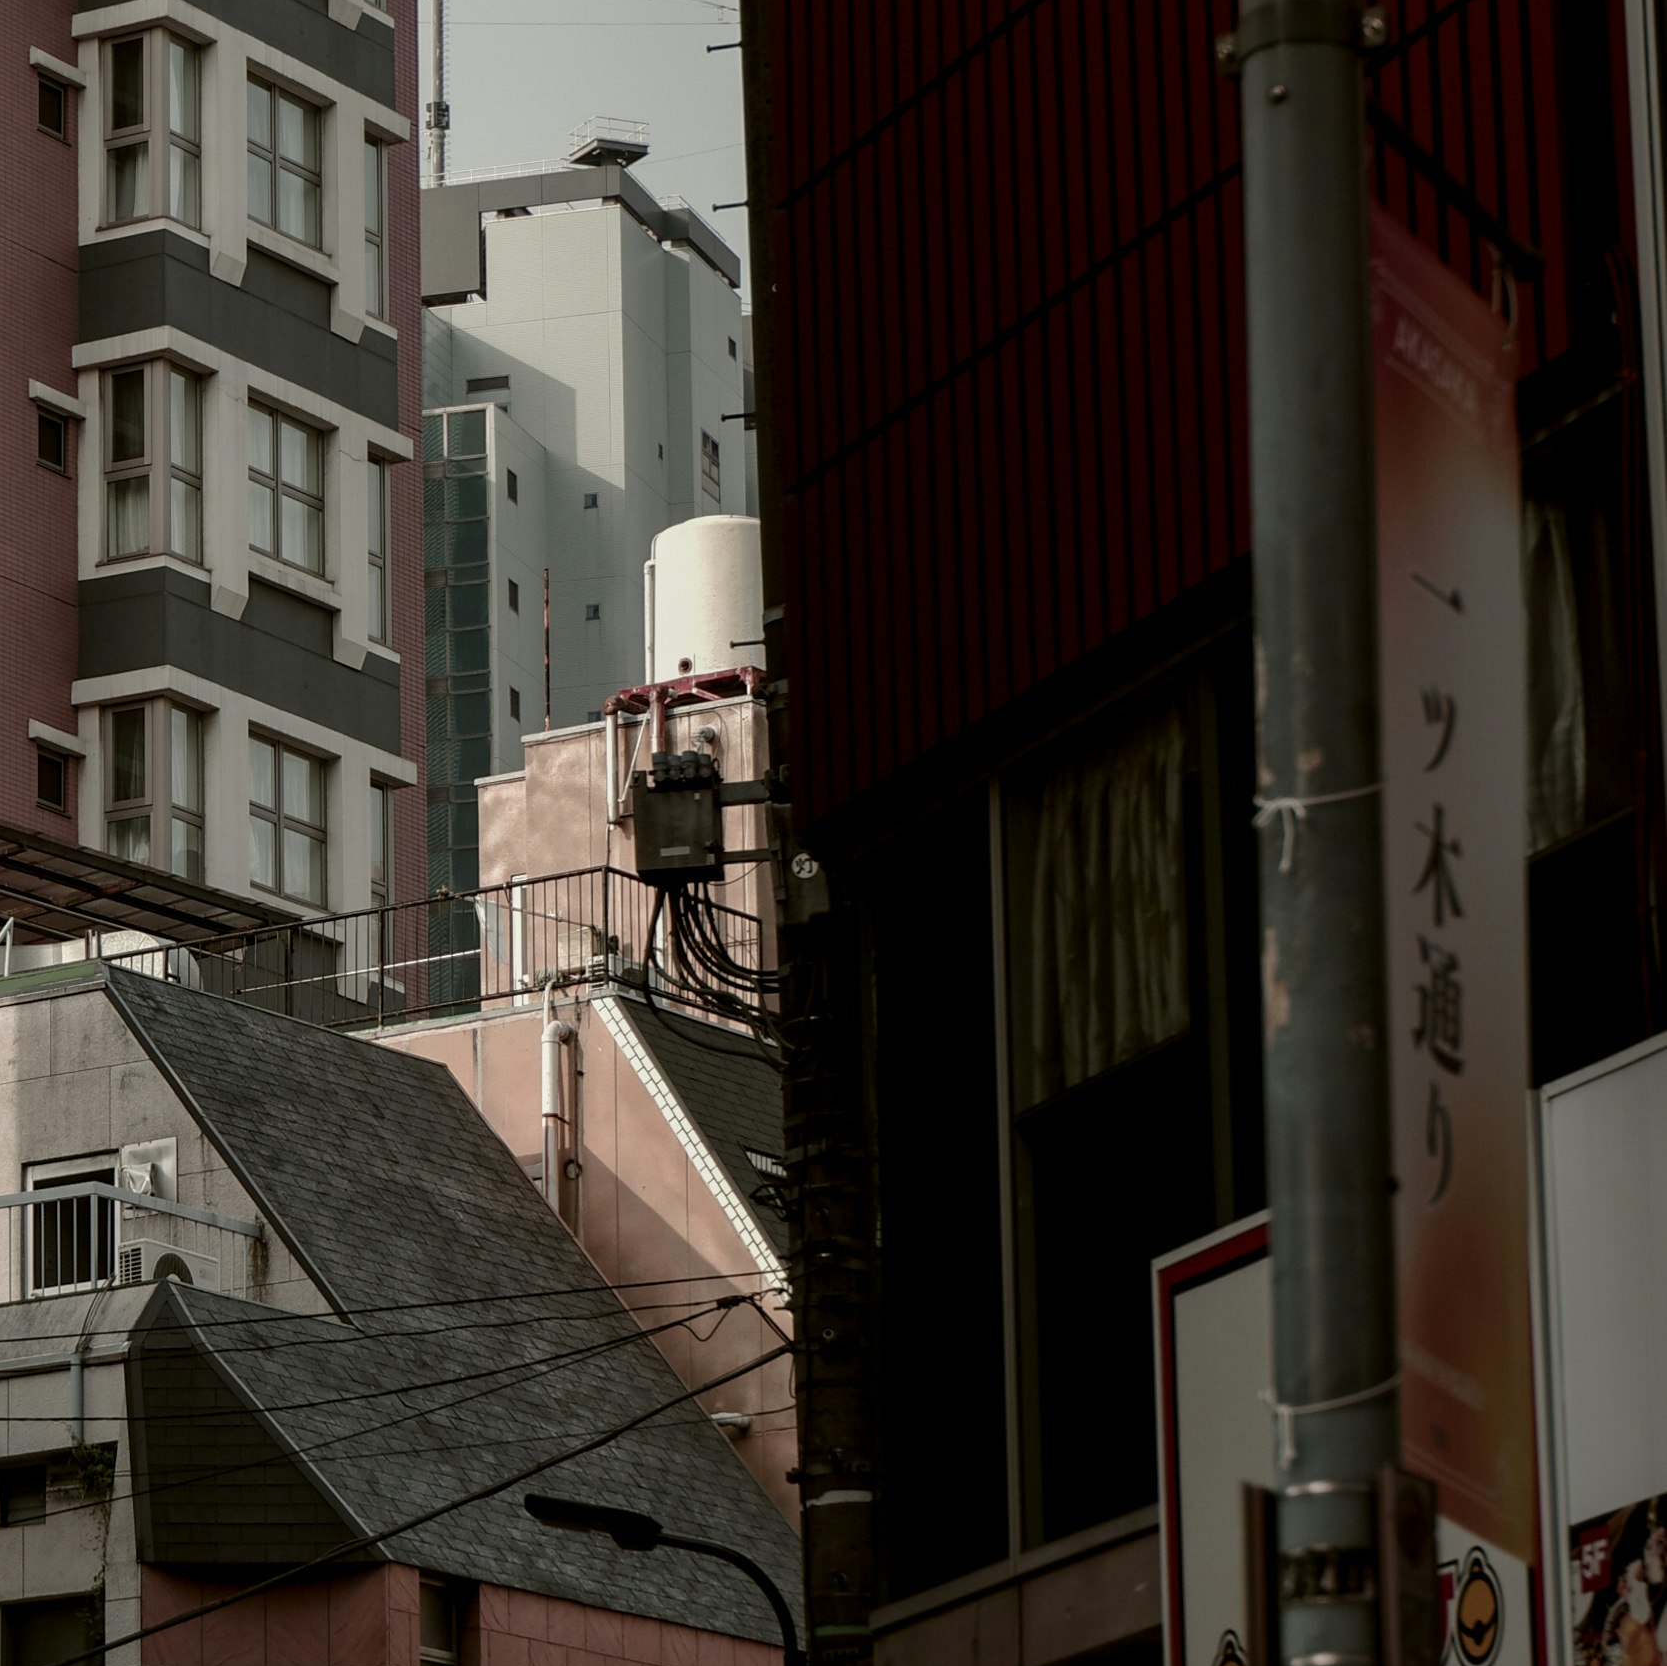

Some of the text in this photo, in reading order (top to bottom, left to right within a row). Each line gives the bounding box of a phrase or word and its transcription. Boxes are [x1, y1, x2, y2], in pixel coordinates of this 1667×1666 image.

[1411, 572, 1464, 1204] 一ツ木通り
[1582, 1538, 1609, 1580] 5F
